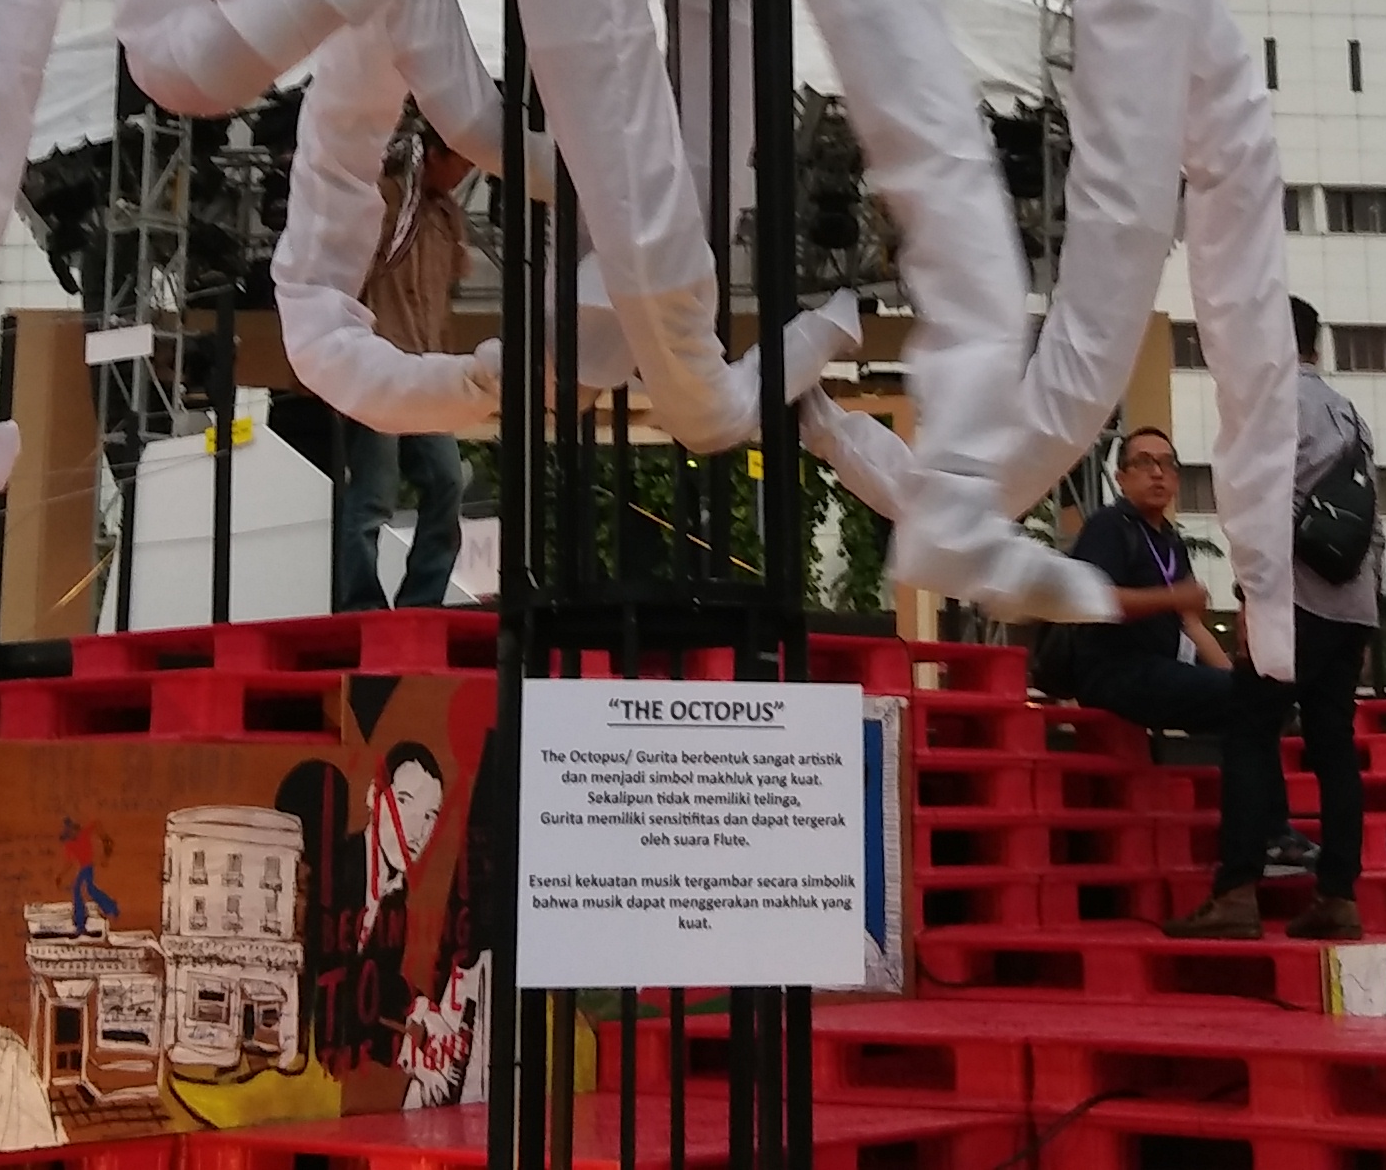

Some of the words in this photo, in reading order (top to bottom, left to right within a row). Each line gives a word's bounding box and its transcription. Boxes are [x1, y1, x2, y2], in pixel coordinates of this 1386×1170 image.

[540, 748, 567, 764] The
[569, 748, 634, 767] Octopus/
[635, 750, 679, 766] Gurita
[681, 749, 751, 766] berbentuk
[752, 753, 796, 769] sangat
[797, 752, 844, 767] artistik
[560, 769, 588, 785] dan
[590, 769, 647, 789] menjadi
[648, 770, 695, 785] simbol
[696, 770, 755, 787] makhluk
[756, 774, 789, 790] yang
[790, 771, 823, 787] kuat.
[587, 790, 655, 808] Sekalipun
[656, 790, 691, 806] tidak
[693, 791, 752, 807] memiliki
[753, 791, 802, 809] telinga,
[539, 810, 584, 826] Gurita
[586, 810, 647, 827] memiliki
[648, 811, 721, 827] sensitifitas
[722, 811, 749, 827] dan
[751, 811, 790, 830] dapat
[791, 812, 847, 831] tergerak
[639, 831, 671, 847] oleh
[673, 835, 711, 848] suara
[713, 831, 751, 849] Flute.
[528, 873, 573, 889] Esensi
[574, 873, 638, 889] kekuatan
[640, 873, 682, 889] musik
[683, 873, 754, 892] tergambar
[756, 877, 799, 889] secara
[801, 873, 857, 890] simbolik
[532, 894, 580, 910] bahwa
[581, 893, 624, 910] musik
[625, 894, 667, 912] dapat
[668, 894, 760, 913] menggerakan
[761, 894, 819, 910] makhluk
[820, 897, 853, 912] yang
[678, 915, 713, 931] kuat.
[317, 959, 381, 1043] TO
